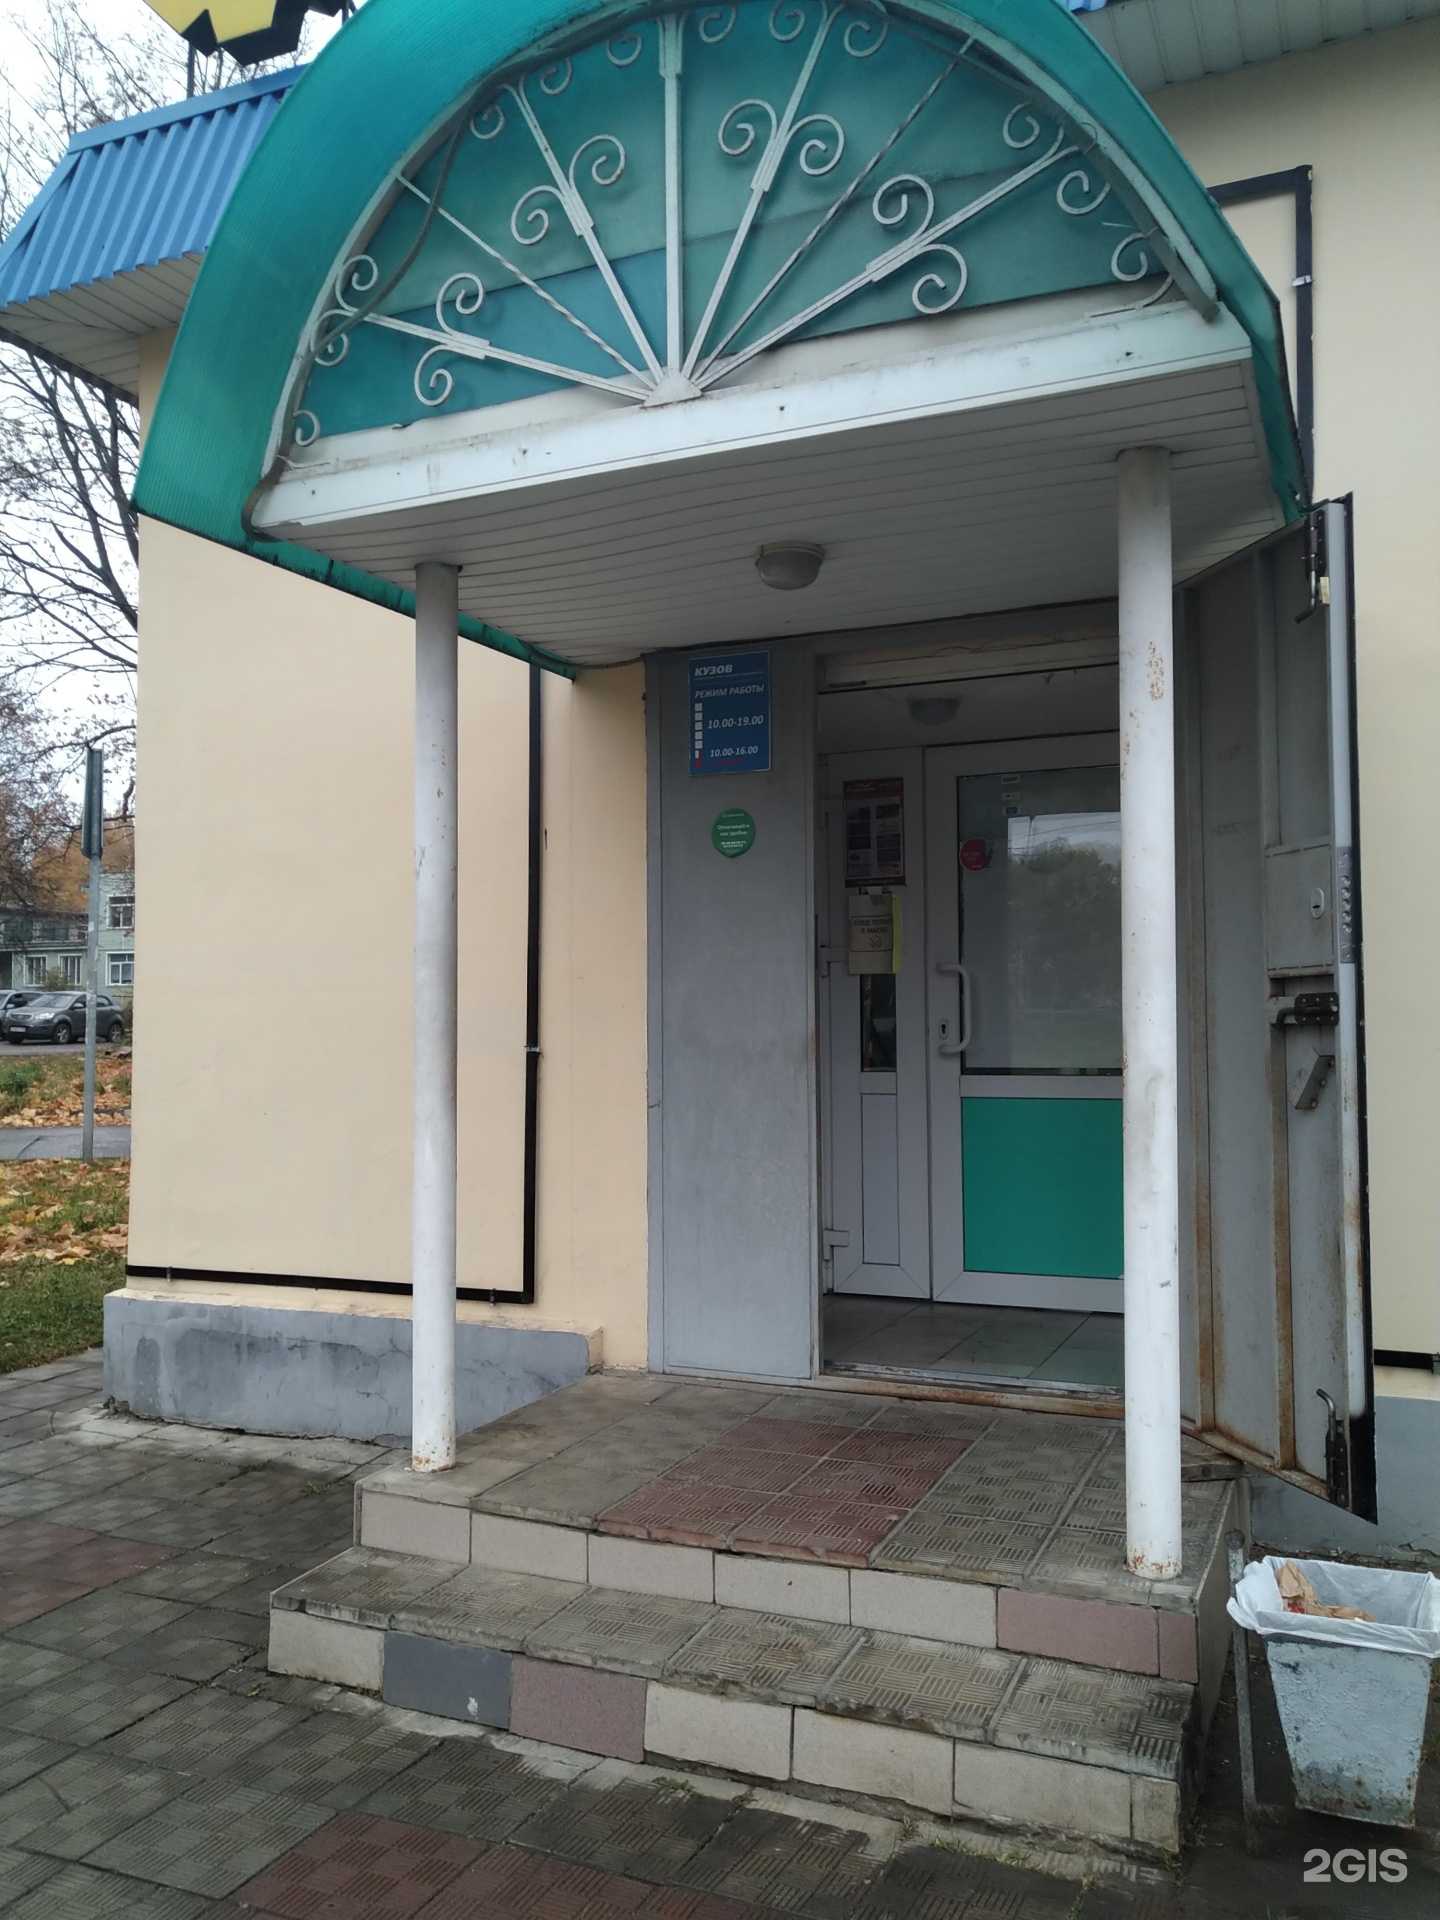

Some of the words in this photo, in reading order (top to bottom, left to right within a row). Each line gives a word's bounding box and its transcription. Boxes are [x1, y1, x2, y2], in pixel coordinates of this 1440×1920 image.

[695, 664, 733, 676] КУЗОВ
[695, 687, 728, 698] РЕЖИМ
[729, 683, 765, 696] РАБОТЫ
